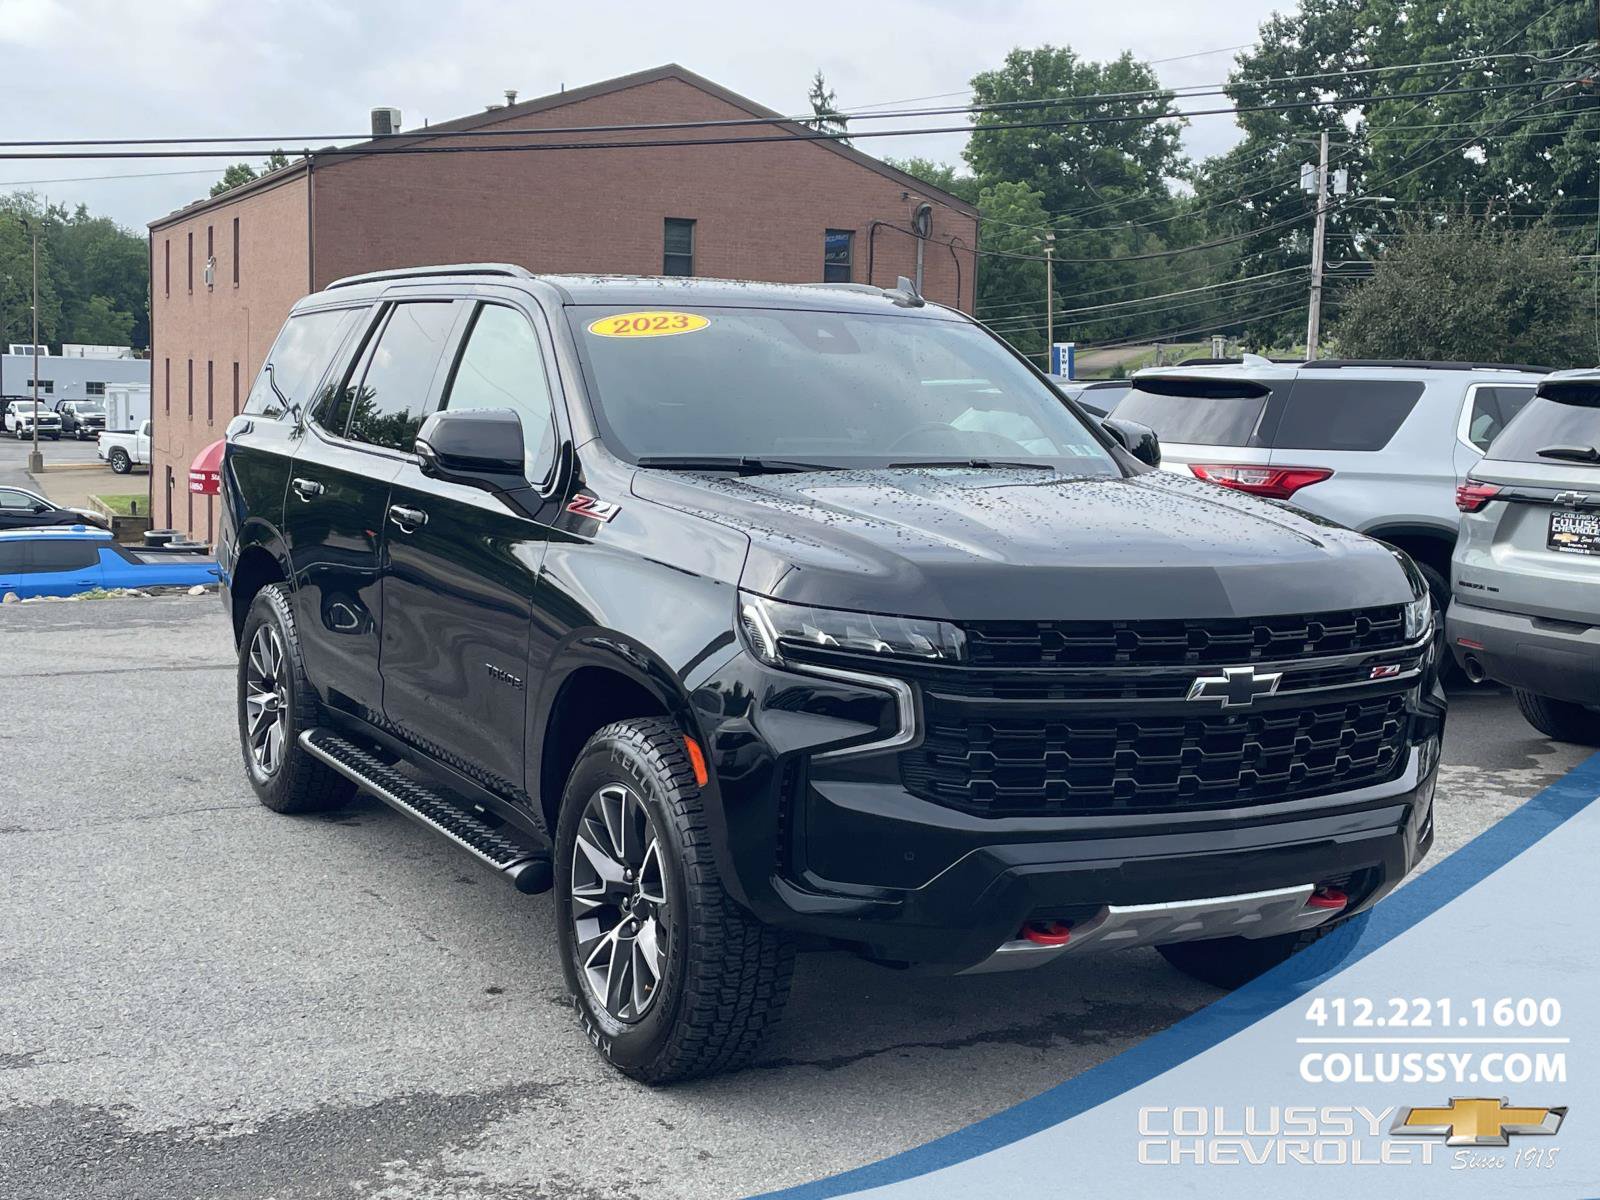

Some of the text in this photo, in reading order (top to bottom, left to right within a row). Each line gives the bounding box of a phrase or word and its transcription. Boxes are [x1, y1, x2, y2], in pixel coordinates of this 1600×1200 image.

[613, 315, 689, 334] 2023
[1552, 517, 1600, 529] COLUSS
[485, 663, 523, 691] TAHOE
[610, 747, 660, 802] KELLY
